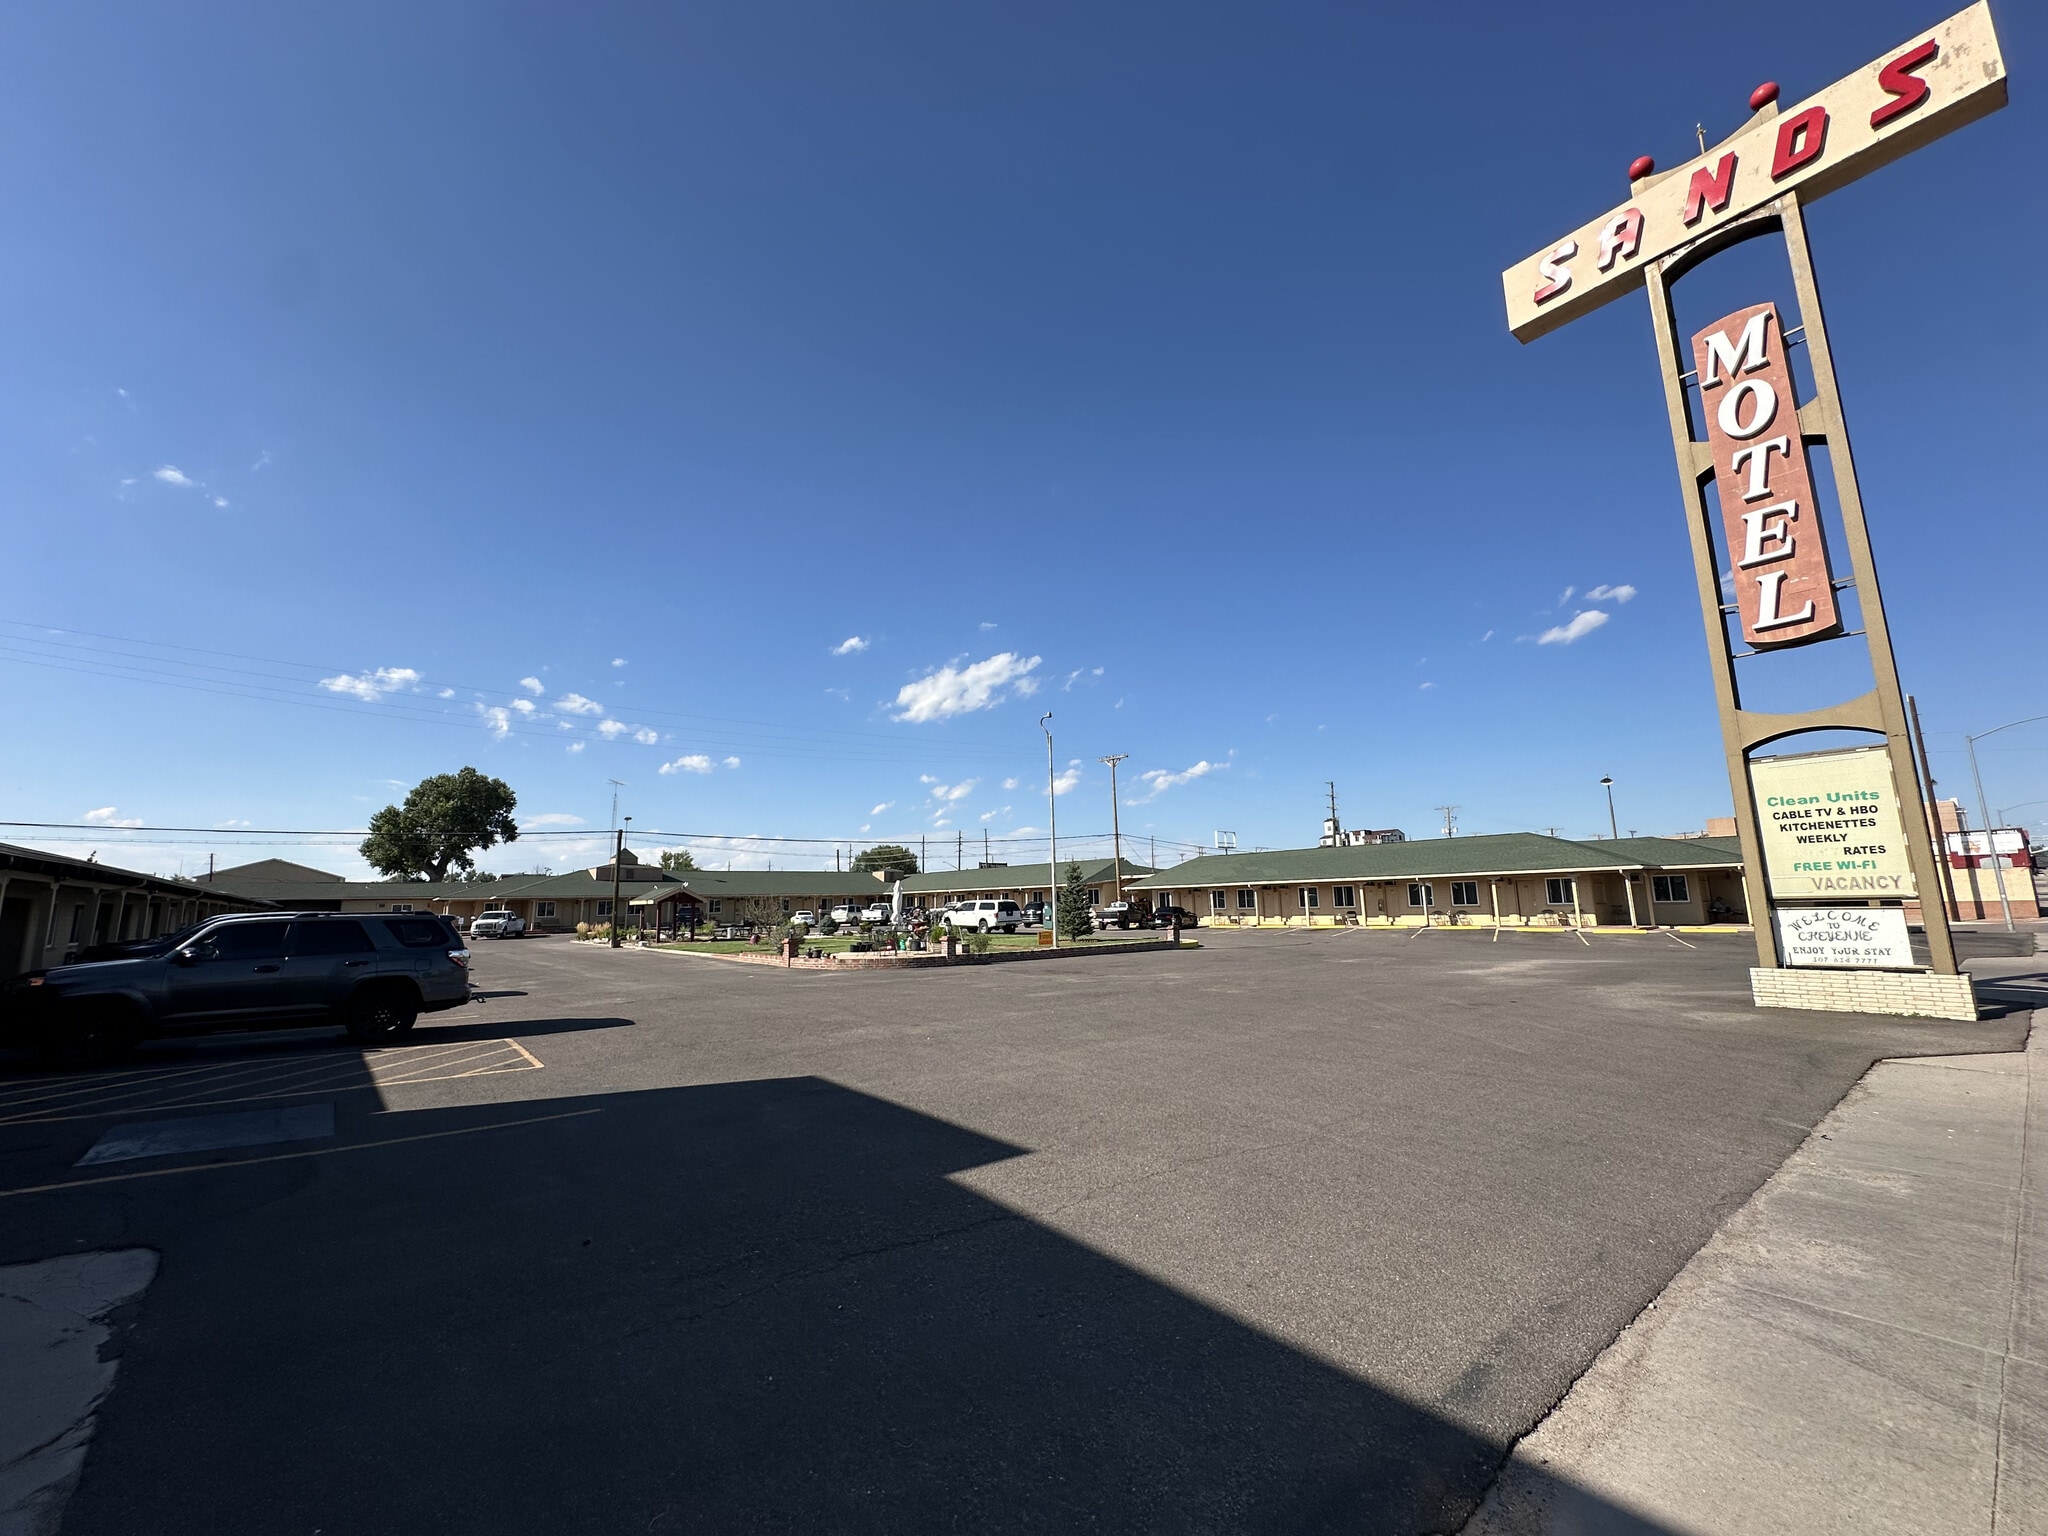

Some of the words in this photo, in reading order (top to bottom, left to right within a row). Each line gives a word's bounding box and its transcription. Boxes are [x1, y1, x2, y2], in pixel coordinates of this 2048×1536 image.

[1534, 38, 1939, 307] SANDS
[1702, 310, 1816, 634] MOTEL
[1767, 796, 1820, 807] Clean
[1826, 791, 1880, 803] Units
[1772, 809, 1812, 820] CABLE
[1815, 808, 1832, 817] TV
[1836, 807, 1846, 816] &
[1850, 805, 1878, 815] HBO
[1780, 818, 1876, 832] KITCHENETTES
[1796, 833, 1848, 844] WEEKLY
[1843, 845, 1886, 855] RATES
[1793, 861, 1832, 871] FREE
[1836, 860, 1877, 870] WI-FI
[1811, 875, 1902, 891] VACANCY
[1788, 910, 1880, 931] WELCOME
[1798, 930, 1873, 942] CHEYENNE
[1793, 946, 1825, 955] ENJOY
[1864, 947, 1892, 956] STAY
